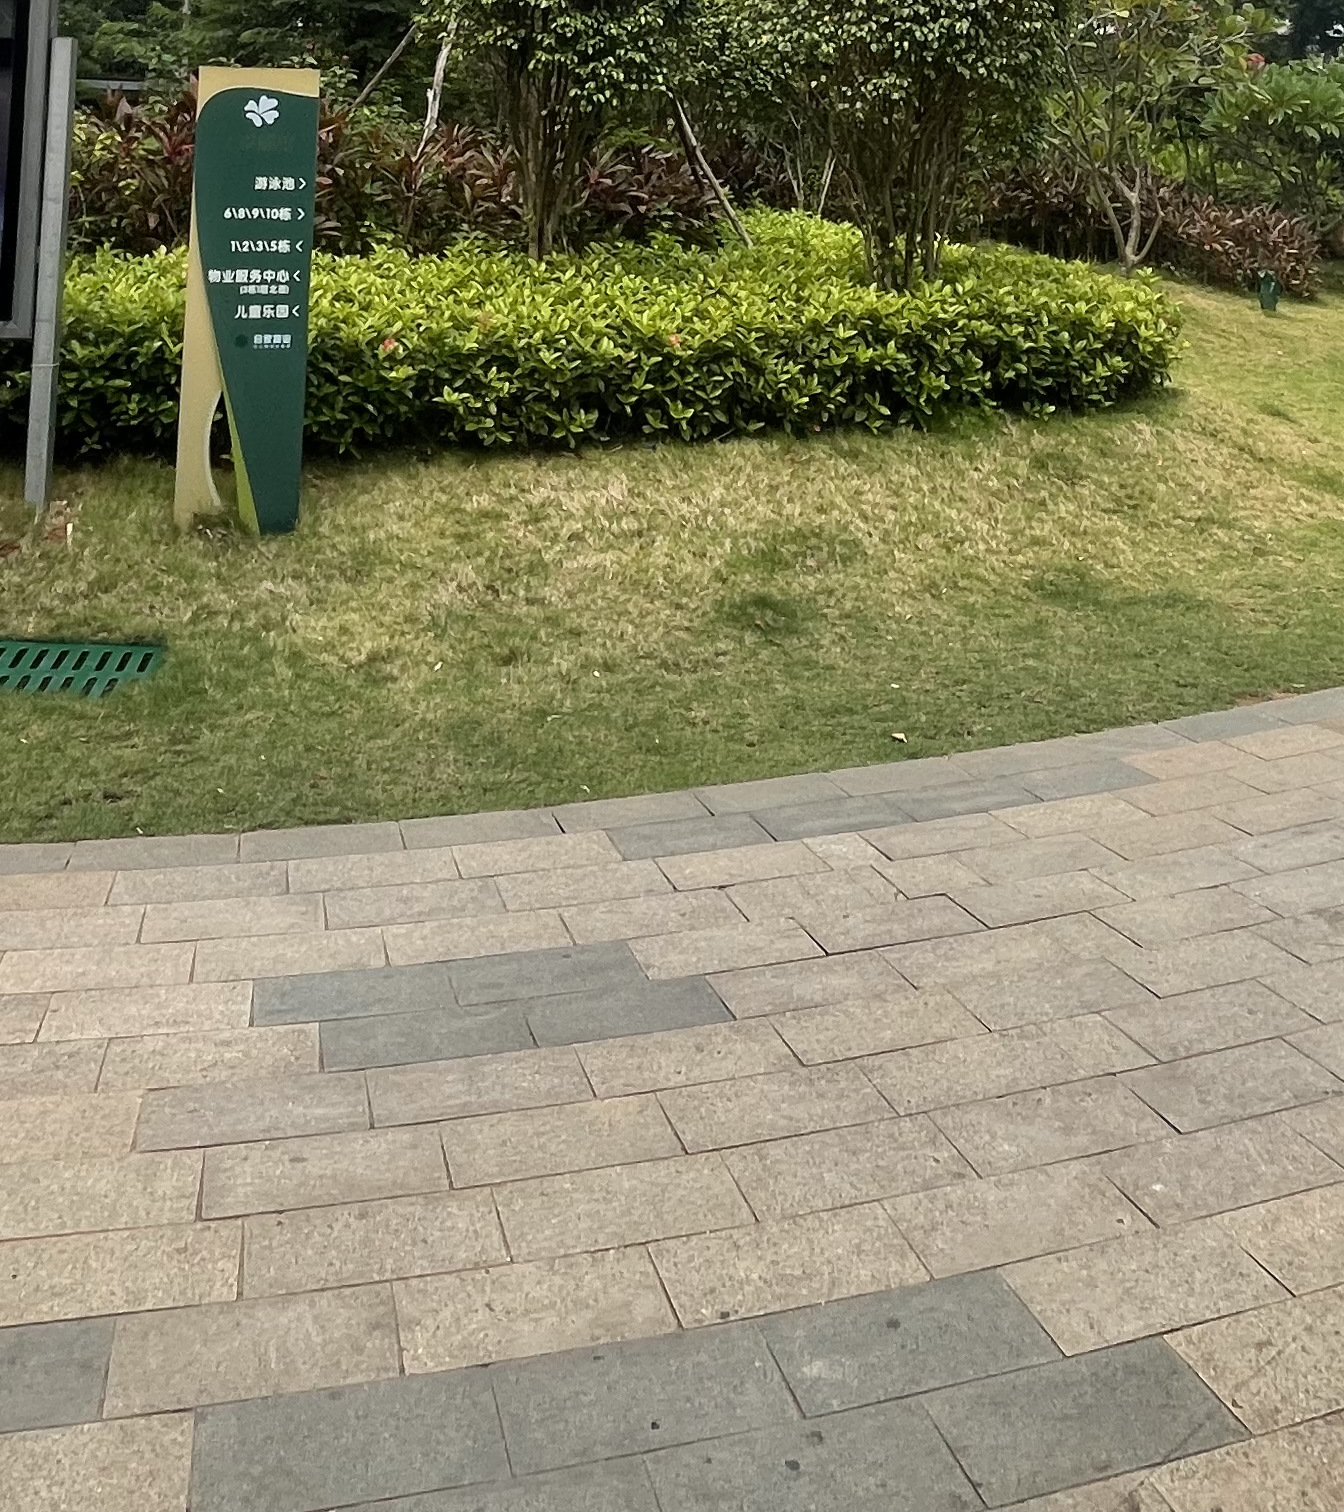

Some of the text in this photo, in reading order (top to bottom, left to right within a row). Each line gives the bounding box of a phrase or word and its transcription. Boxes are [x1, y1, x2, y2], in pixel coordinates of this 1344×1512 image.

[254, 176, 296, 191] 游泳池
[207, 268, 290, 284] 物业服务中心
[234, 304, 290, 319] 儿童乐园
